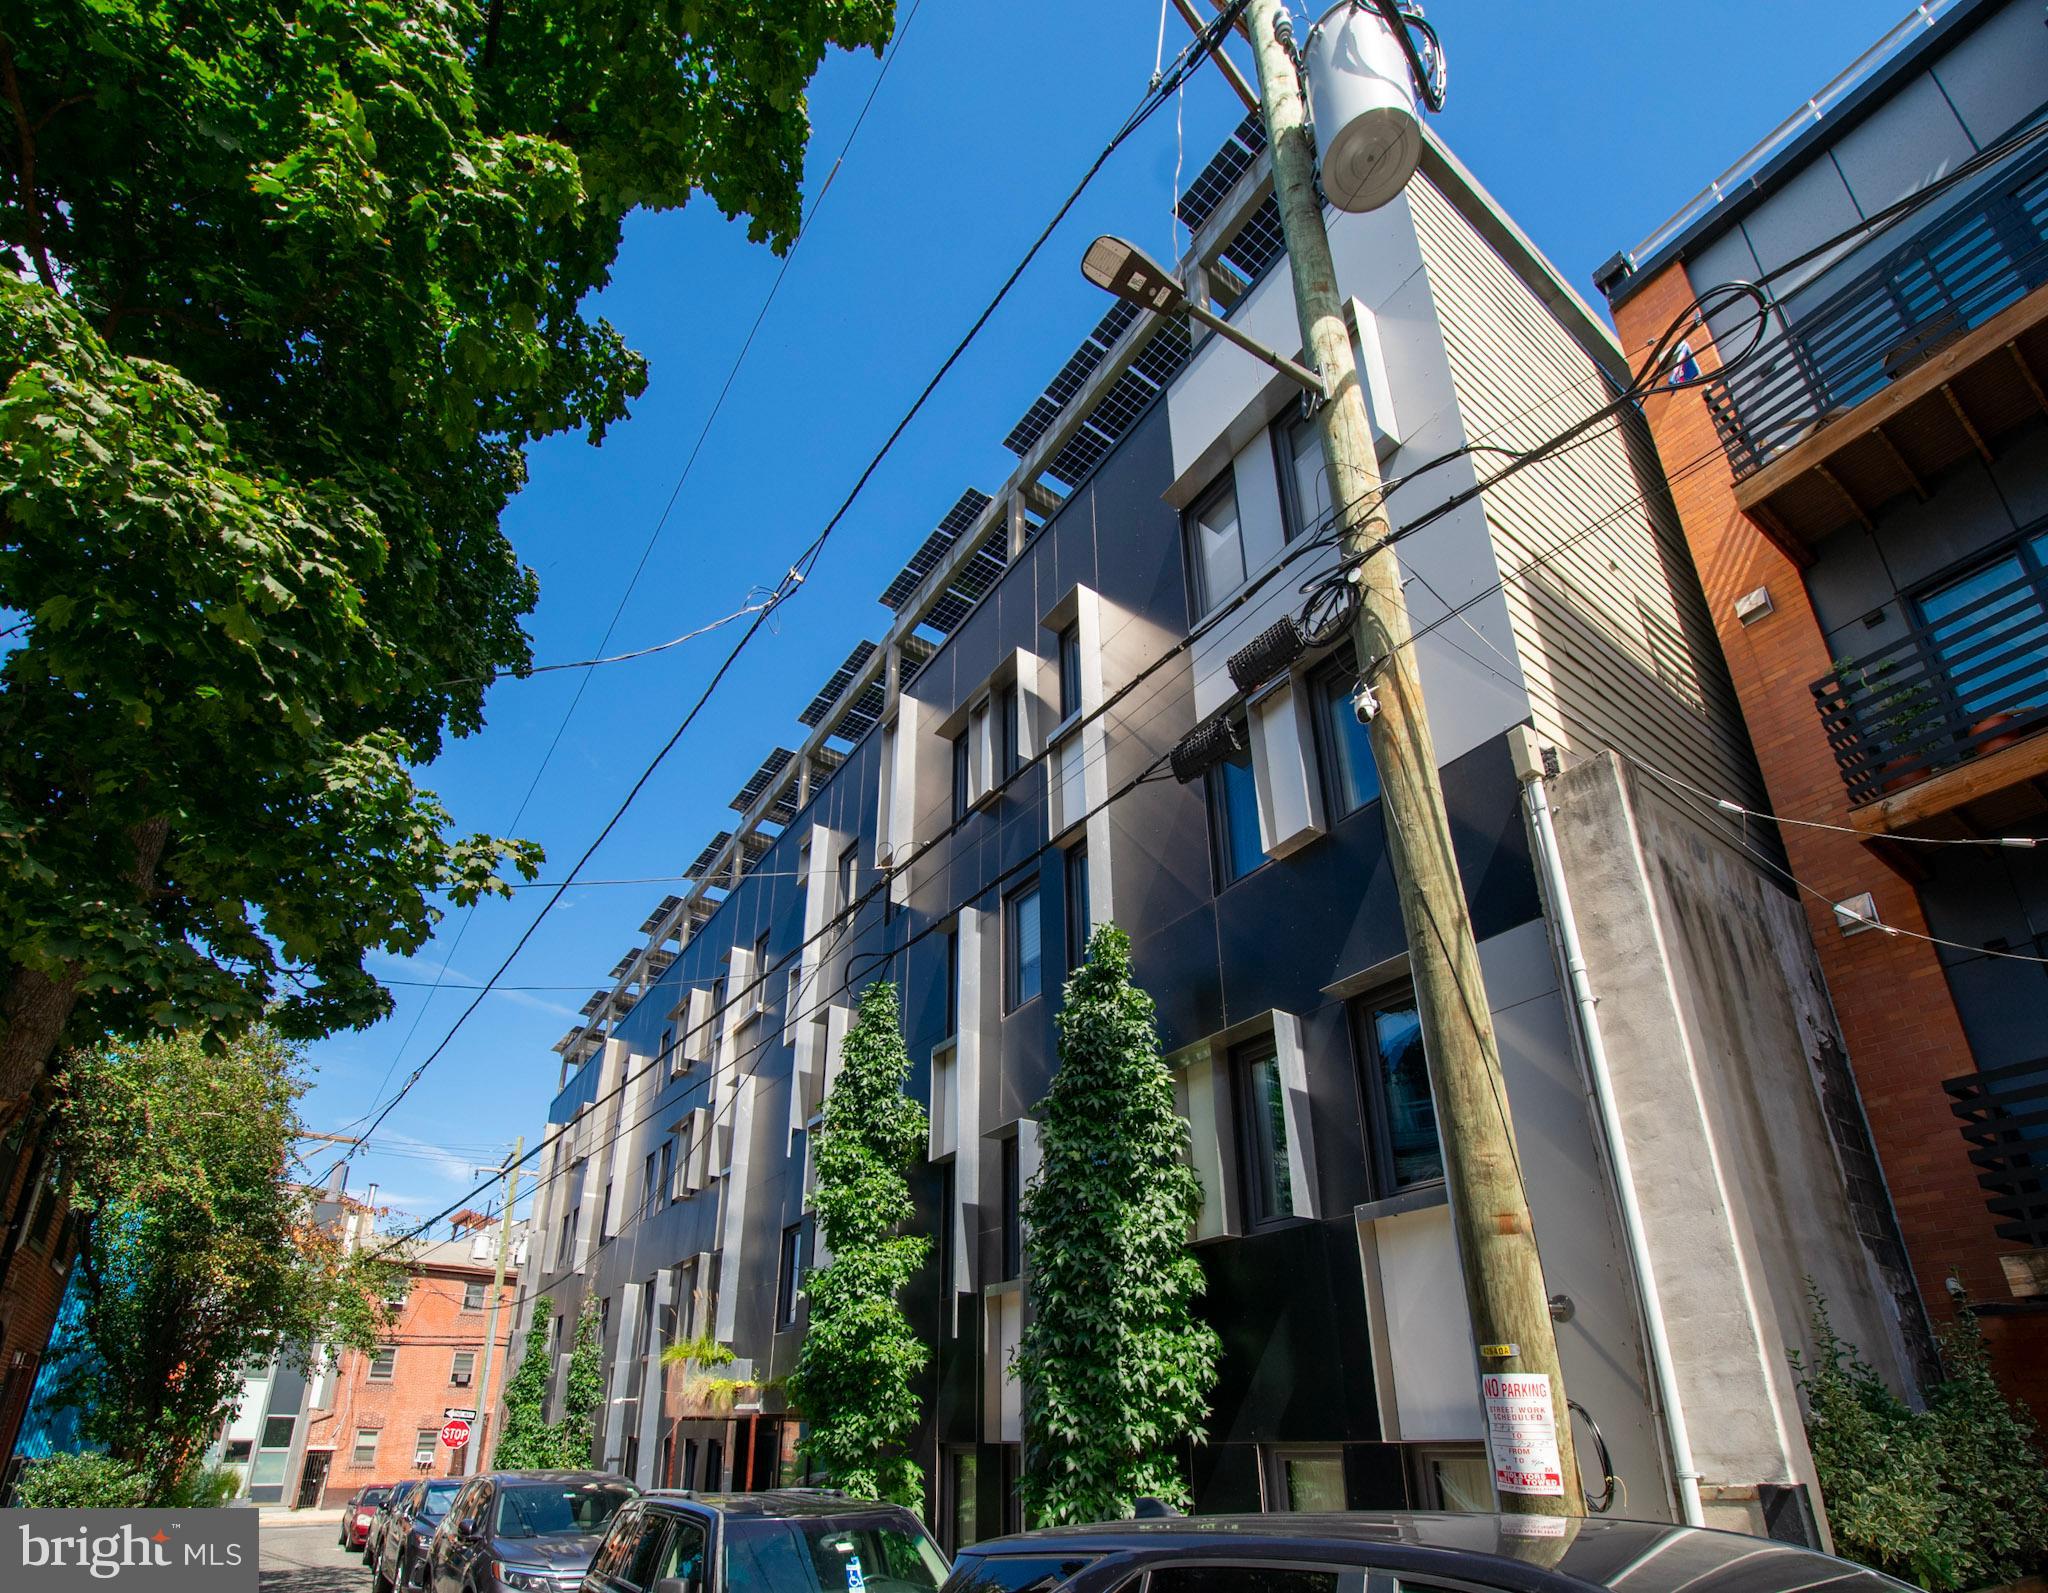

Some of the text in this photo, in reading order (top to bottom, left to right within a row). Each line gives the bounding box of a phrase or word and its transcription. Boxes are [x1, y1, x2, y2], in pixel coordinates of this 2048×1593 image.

[1485, 1379, 1547, 1398] NO PARKING
[1489, 1405, 1514, 1413] STREET
[443, 1428, 468, 1440] STOP
[1503, 1471, 1546, 1479] VIOLATORS
